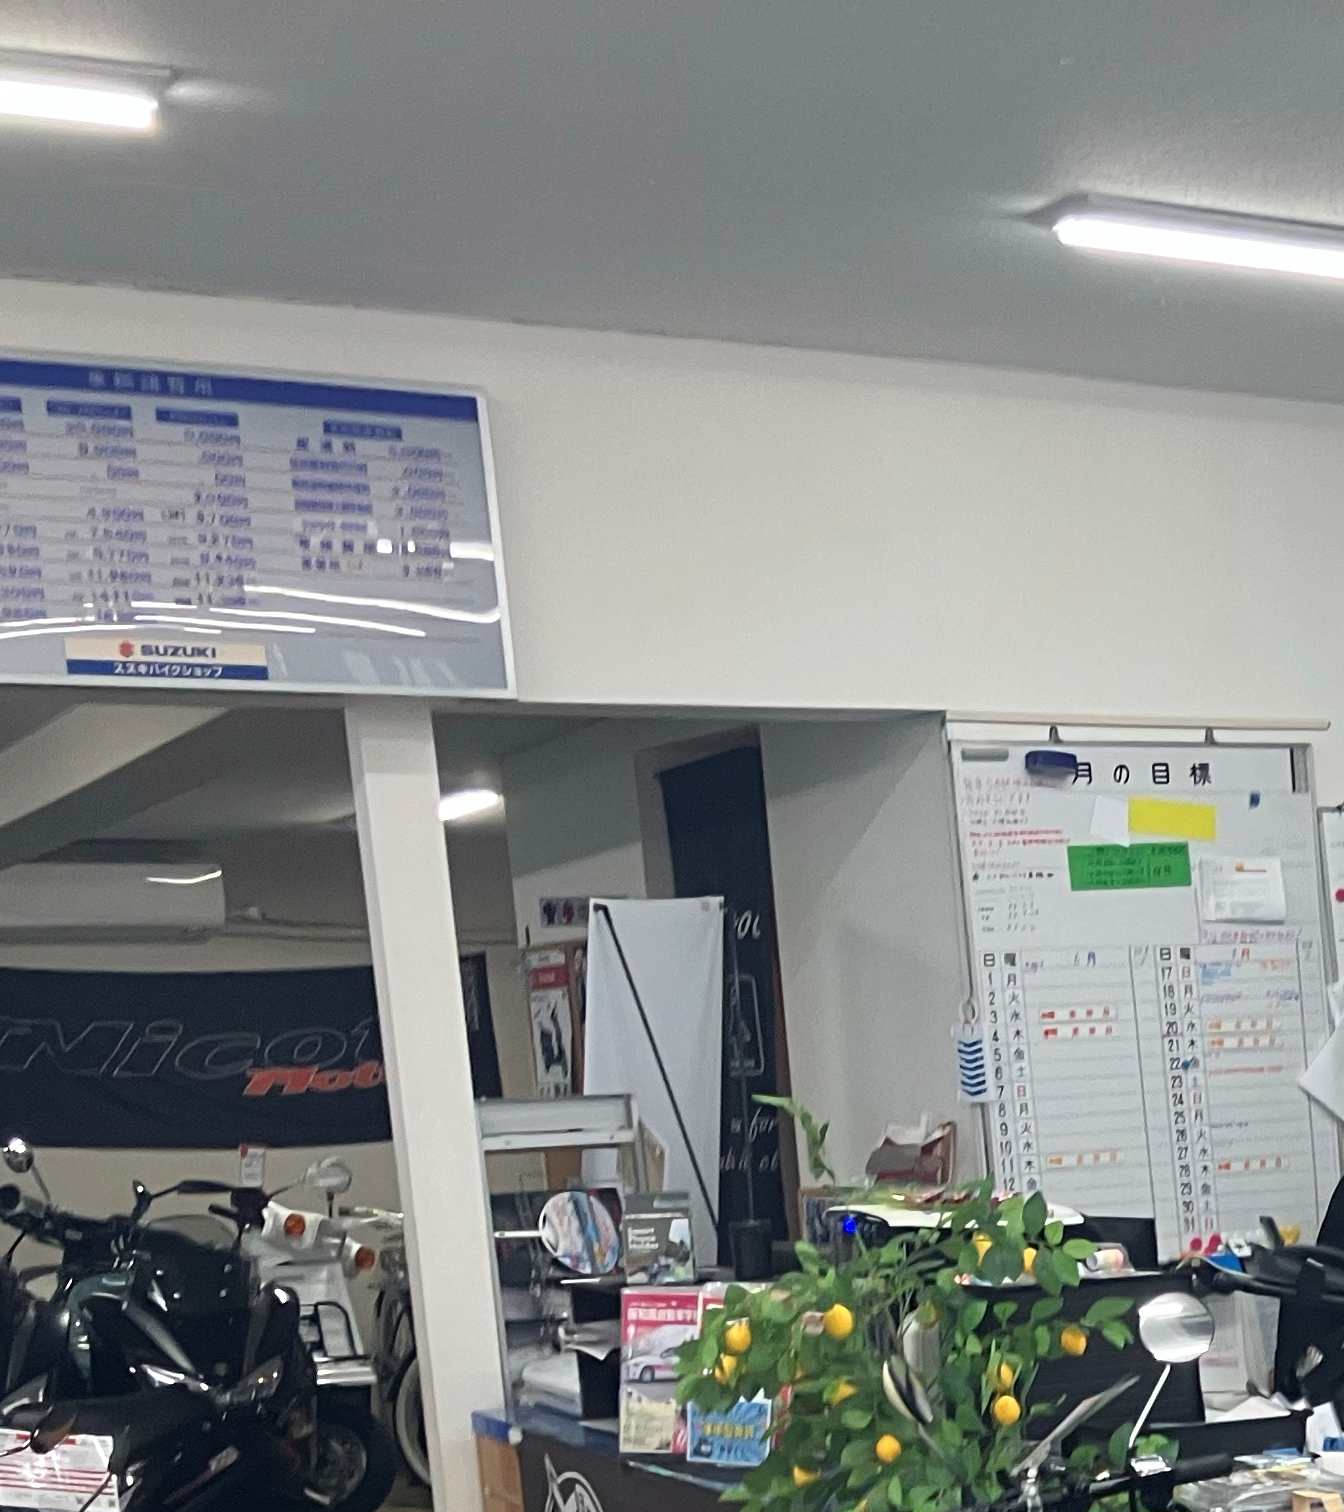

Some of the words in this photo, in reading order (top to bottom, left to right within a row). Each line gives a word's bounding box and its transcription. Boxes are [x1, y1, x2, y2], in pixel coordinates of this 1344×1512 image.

[139, 643, 217, 658] SUZUKI
[113, 662, 223, 678] スズキバイクショップ
[1073, 762, 1211, 786] 月の目標
[1161, 966, 1172, 979] 17
[988, 974, 992, 985] 1
[1163, 985, 1174, 997] 18
[989, 993, 995, 1005] 2
[1165, 1004, 1176, 1016] 19
[991, 1011, 997, 1023] 3
[1167, 1022, 1178, 1034] 20
[992, 1030, 999, 1042] 4
[1168, 1039, 1180, 1051] 21
[994, 1049, 1001, 1061] 5
[1170, 1057, 1181, 1070] 22
[996, 1068, 1002, 1080] 6
[1171, 1076, 1183, 1088] 23
[998, 1086, 1004, 1098] 7
[1172, 1094, 1184, 1106] 24
[999, 1105, 1006, 1117] 8
[1174, 1112, 1186, 1124] 25
[1000, 1123, 1008, 1136] 9
[1176, 1129, 1187, 1141] 26
[1001, 1141, 1012, 1154] 10
[1178, 1147, 1189, 1159] 27
[1002, 1160, 1013, 1172] 11
[1179, 1165, 1190, 1178] 28
[1003, 1179, 1015, 1191] 12
[1181, 1183, 1192, 1195] 29
[1183, 1201, 1194, 1213] 30
[1184, 1219, 1195, 1231] 31
